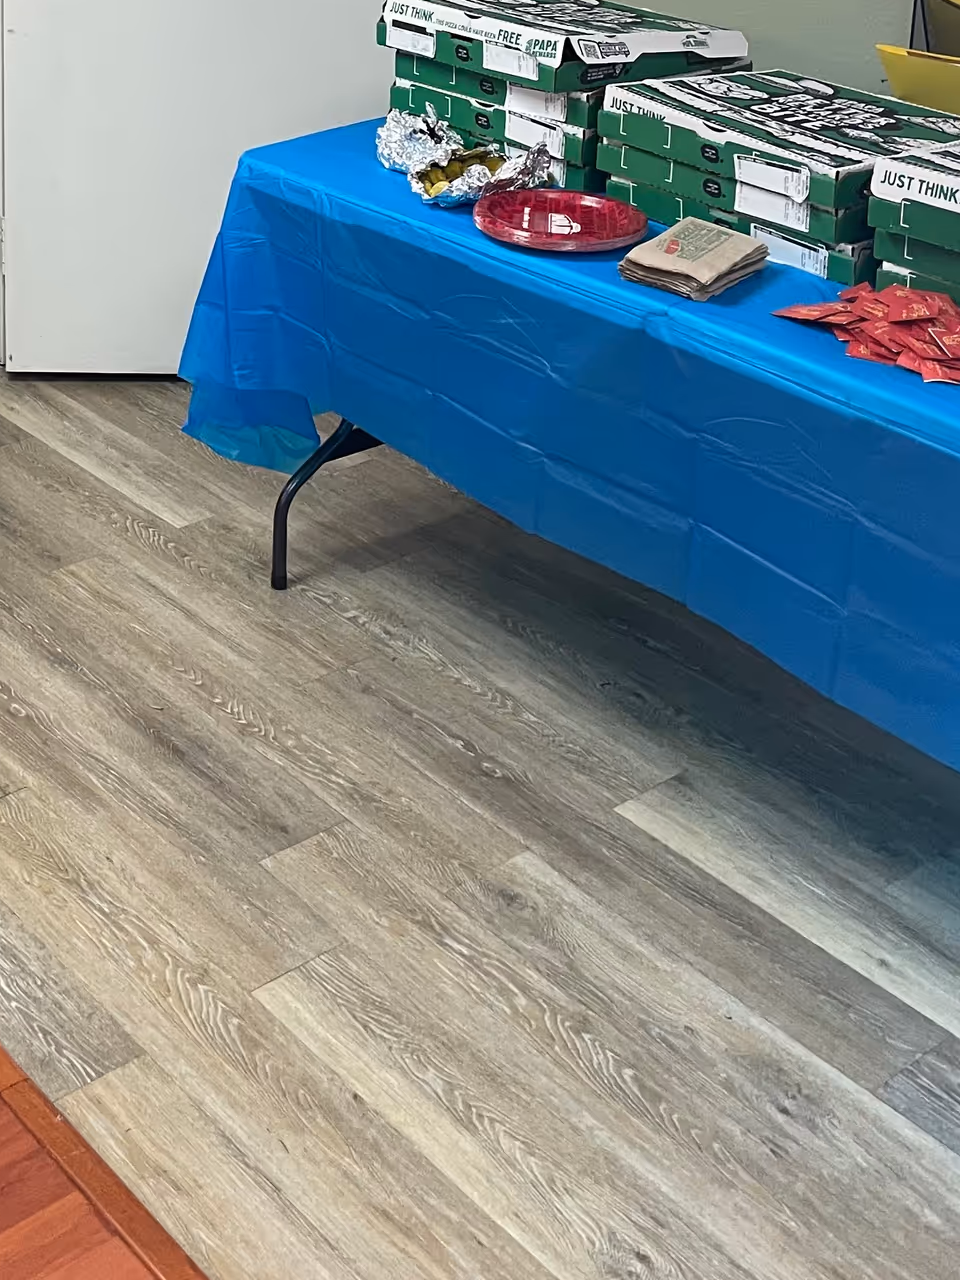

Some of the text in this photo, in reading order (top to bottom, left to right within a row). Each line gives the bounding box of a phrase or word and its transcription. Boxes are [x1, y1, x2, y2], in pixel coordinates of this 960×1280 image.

[390, 1, 410, 16] JUST
[533, 39, 558, 52] PAPA
[610, 96, 635, 113] JUST
[749, 103, 837, 129] BITE
[880, 170, 914, 190] JUST
